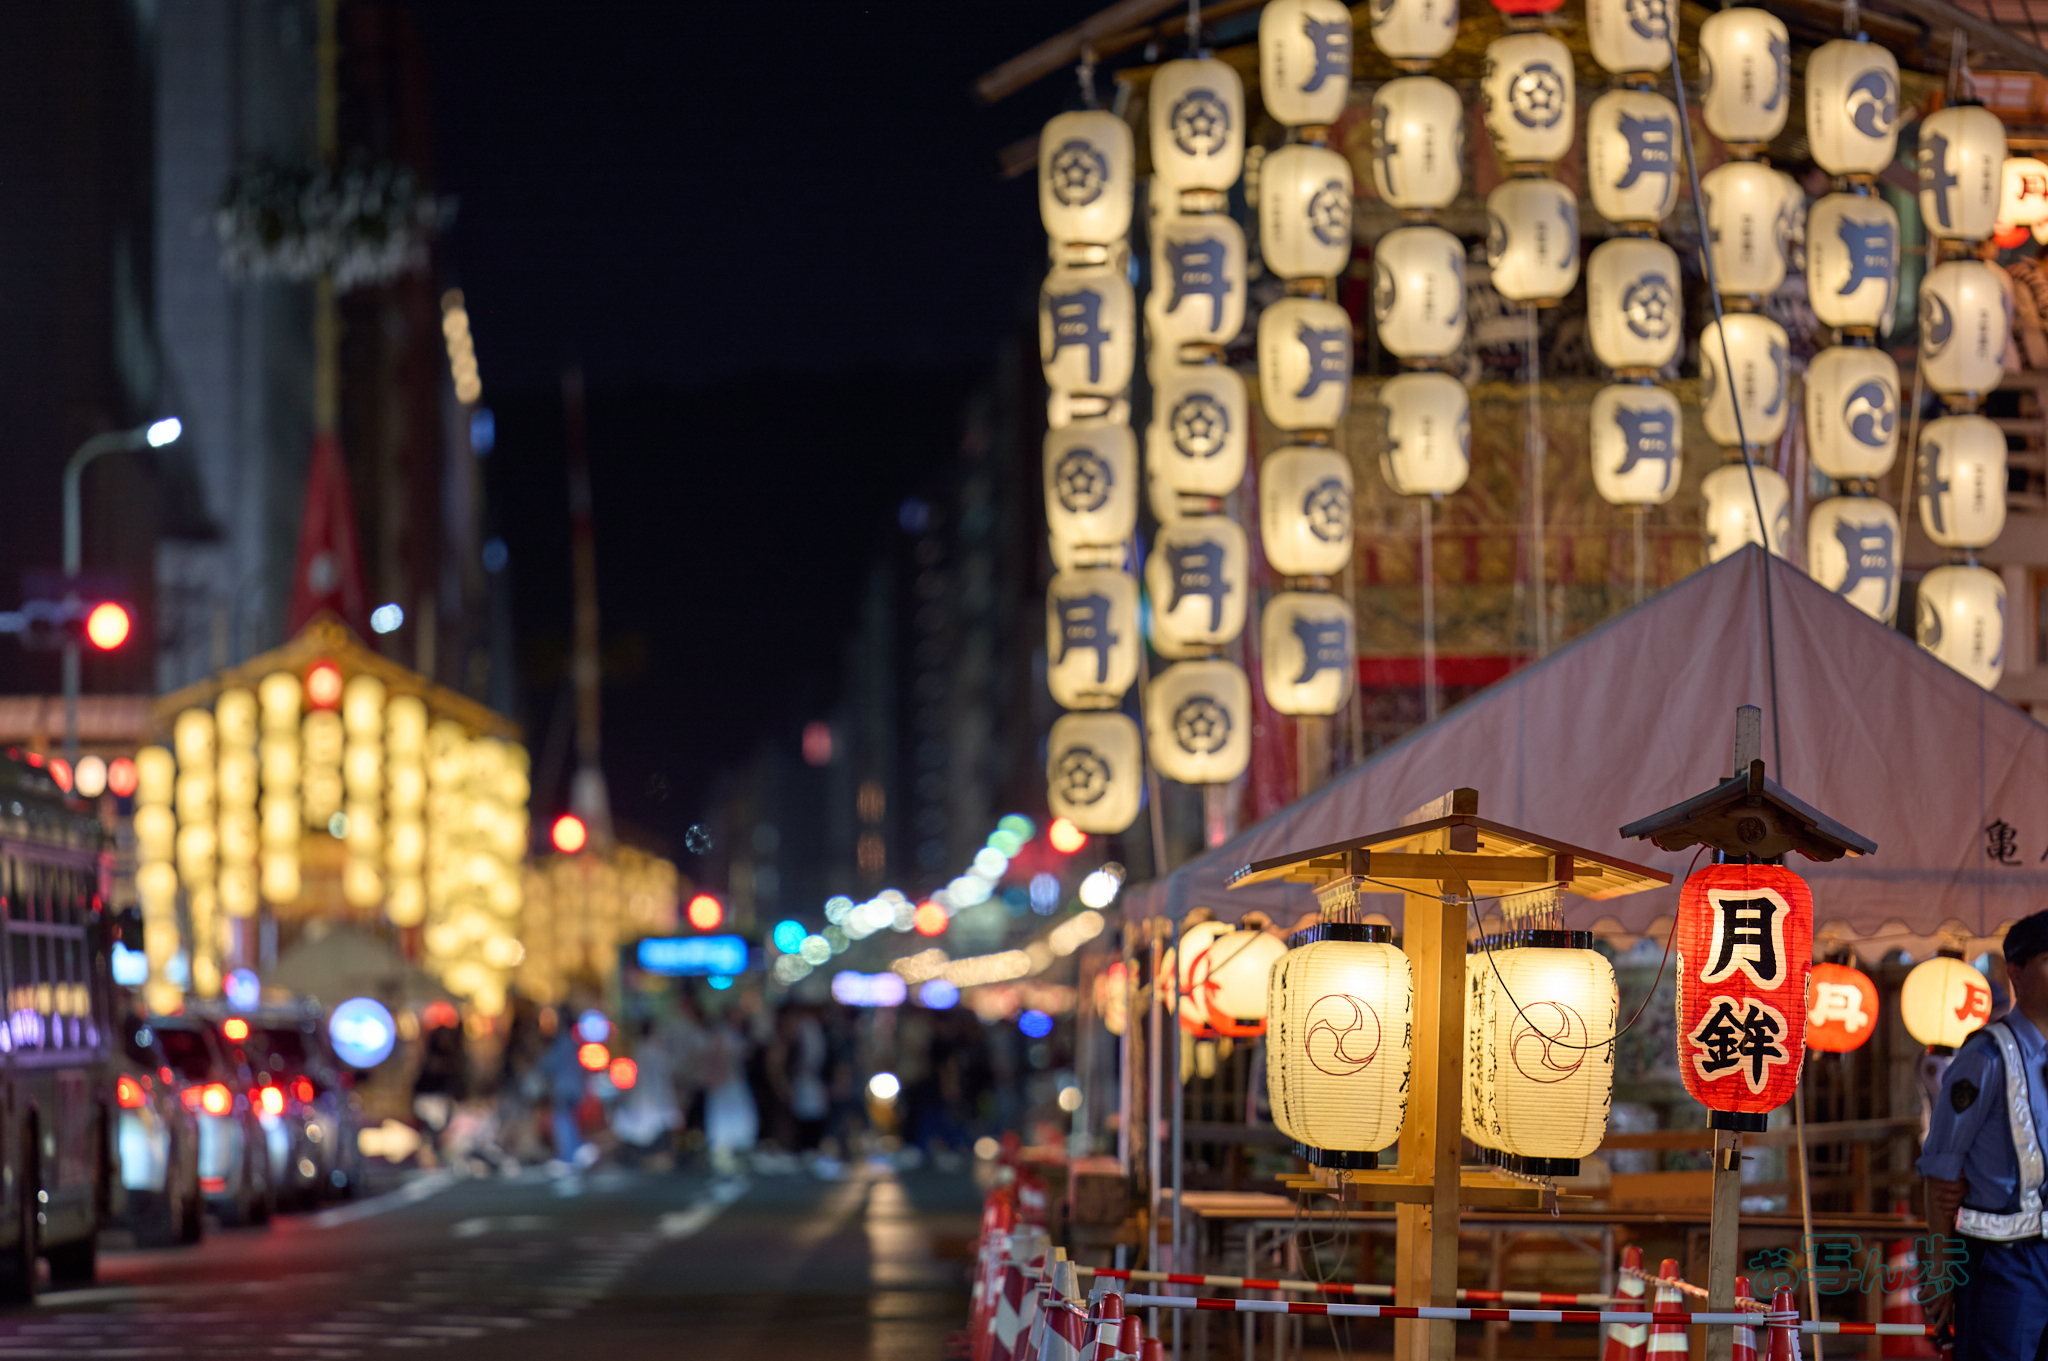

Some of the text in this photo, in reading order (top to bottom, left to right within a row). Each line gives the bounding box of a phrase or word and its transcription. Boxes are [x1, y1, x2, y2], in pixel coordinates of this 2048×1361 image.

[1618, 112, 1674, 212] 月
[1165, 238, 1232, 333] 月
[1838, 215, 1896, 322] 月
[1044, 288, 1111, 384] 月
[1616, 405, 1676, 493] 月
[1166, 541, 1231, 633] 月
[1835, 516, 1895, 616] 月
[1056, 594, 1119, 684] 月
[1985, 817, 2048, 866] 亀
[1693, 894, 1787, 1089] 月鉾
[1808, 980, 1869, 1033] 月
